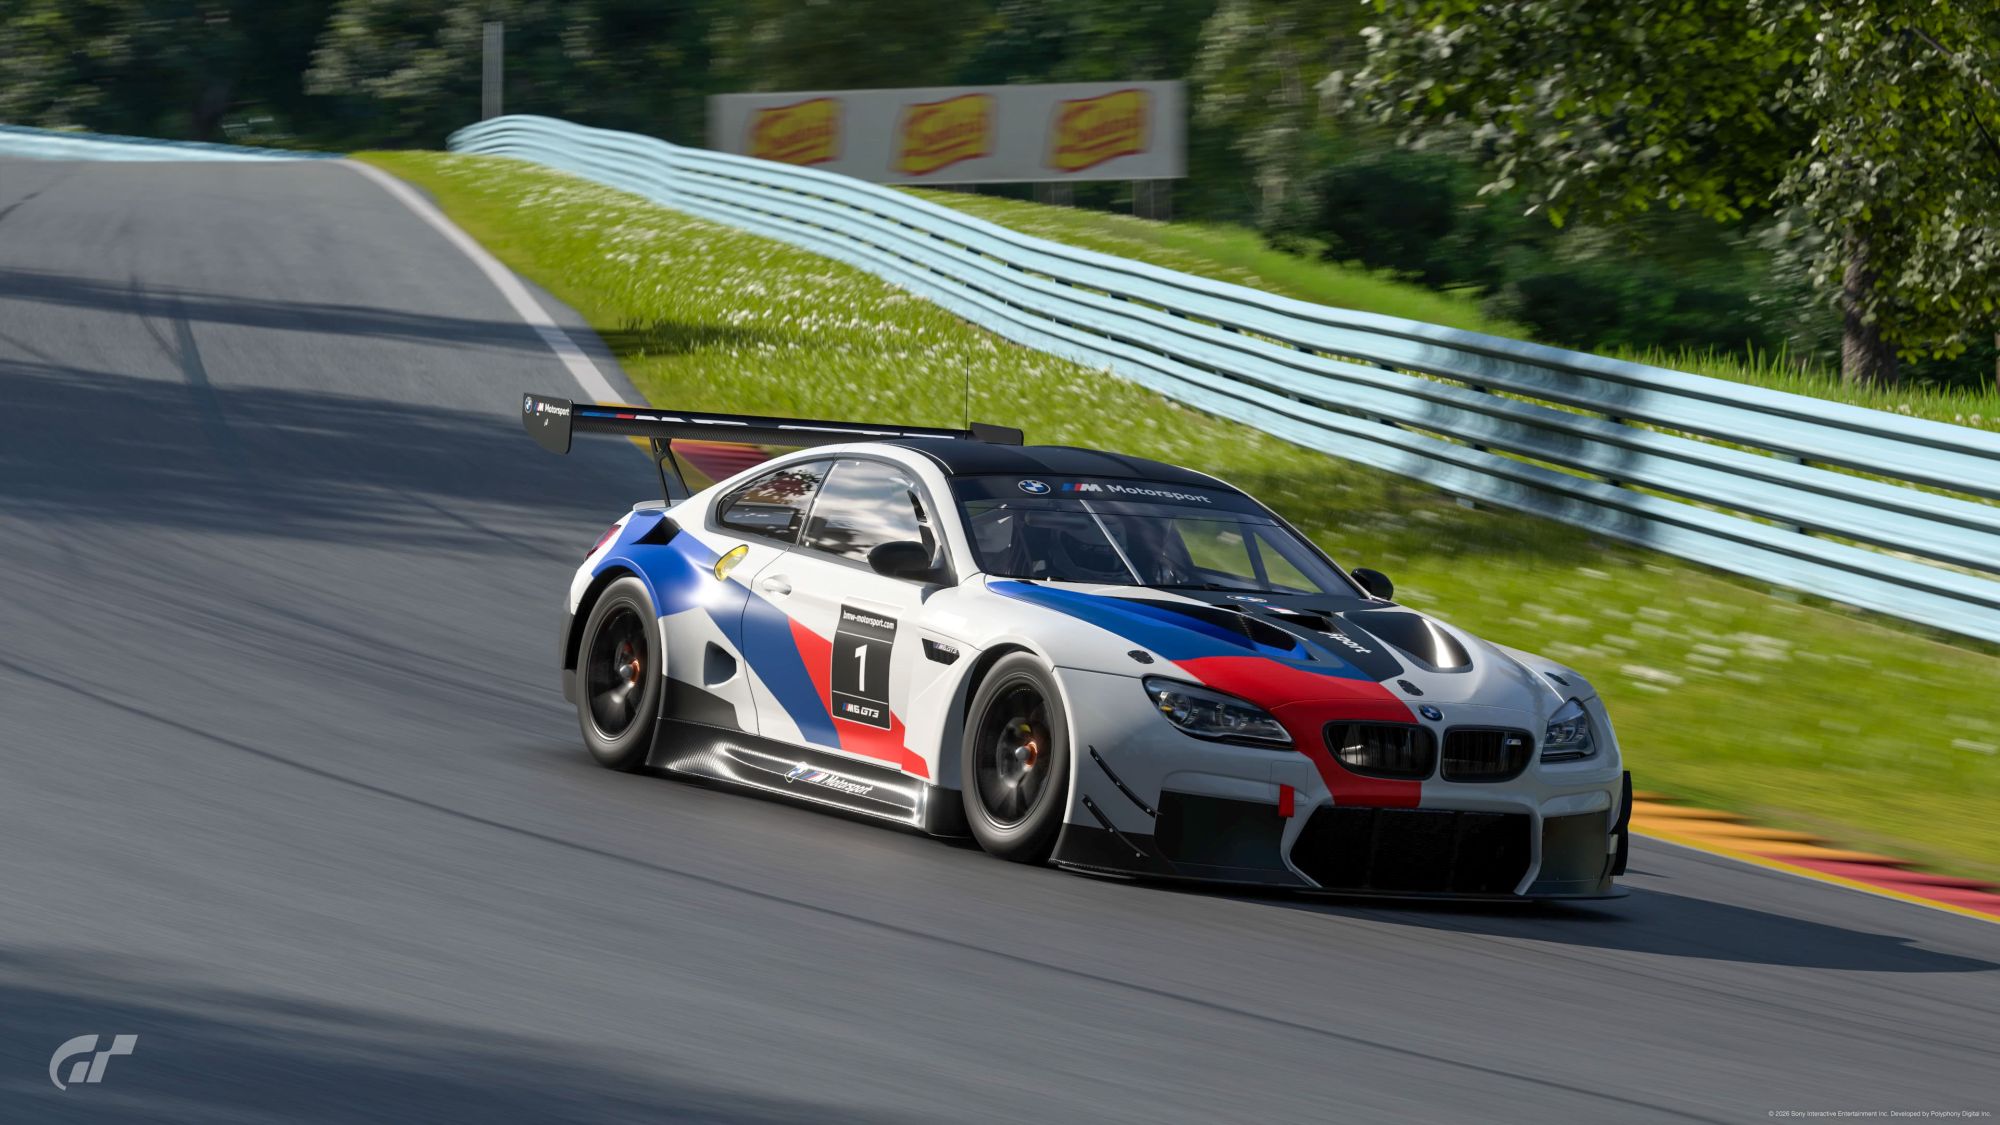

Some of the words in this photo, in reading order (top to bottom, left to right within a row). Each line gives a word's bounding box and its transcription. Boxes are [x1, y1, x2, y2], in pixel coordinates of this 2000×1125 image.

[545, 403, 570, 416] Motorsport
[1105, 484, 1212, 504] Motorsport
[843, 610, 894, 629] bmw-motorsport.com
[855, 644, 867, 691] 1
[845, 702, 860, 714] M6
[860, 706, 880, 719] GT3
[822, 775, 873, 794] Motorsport
